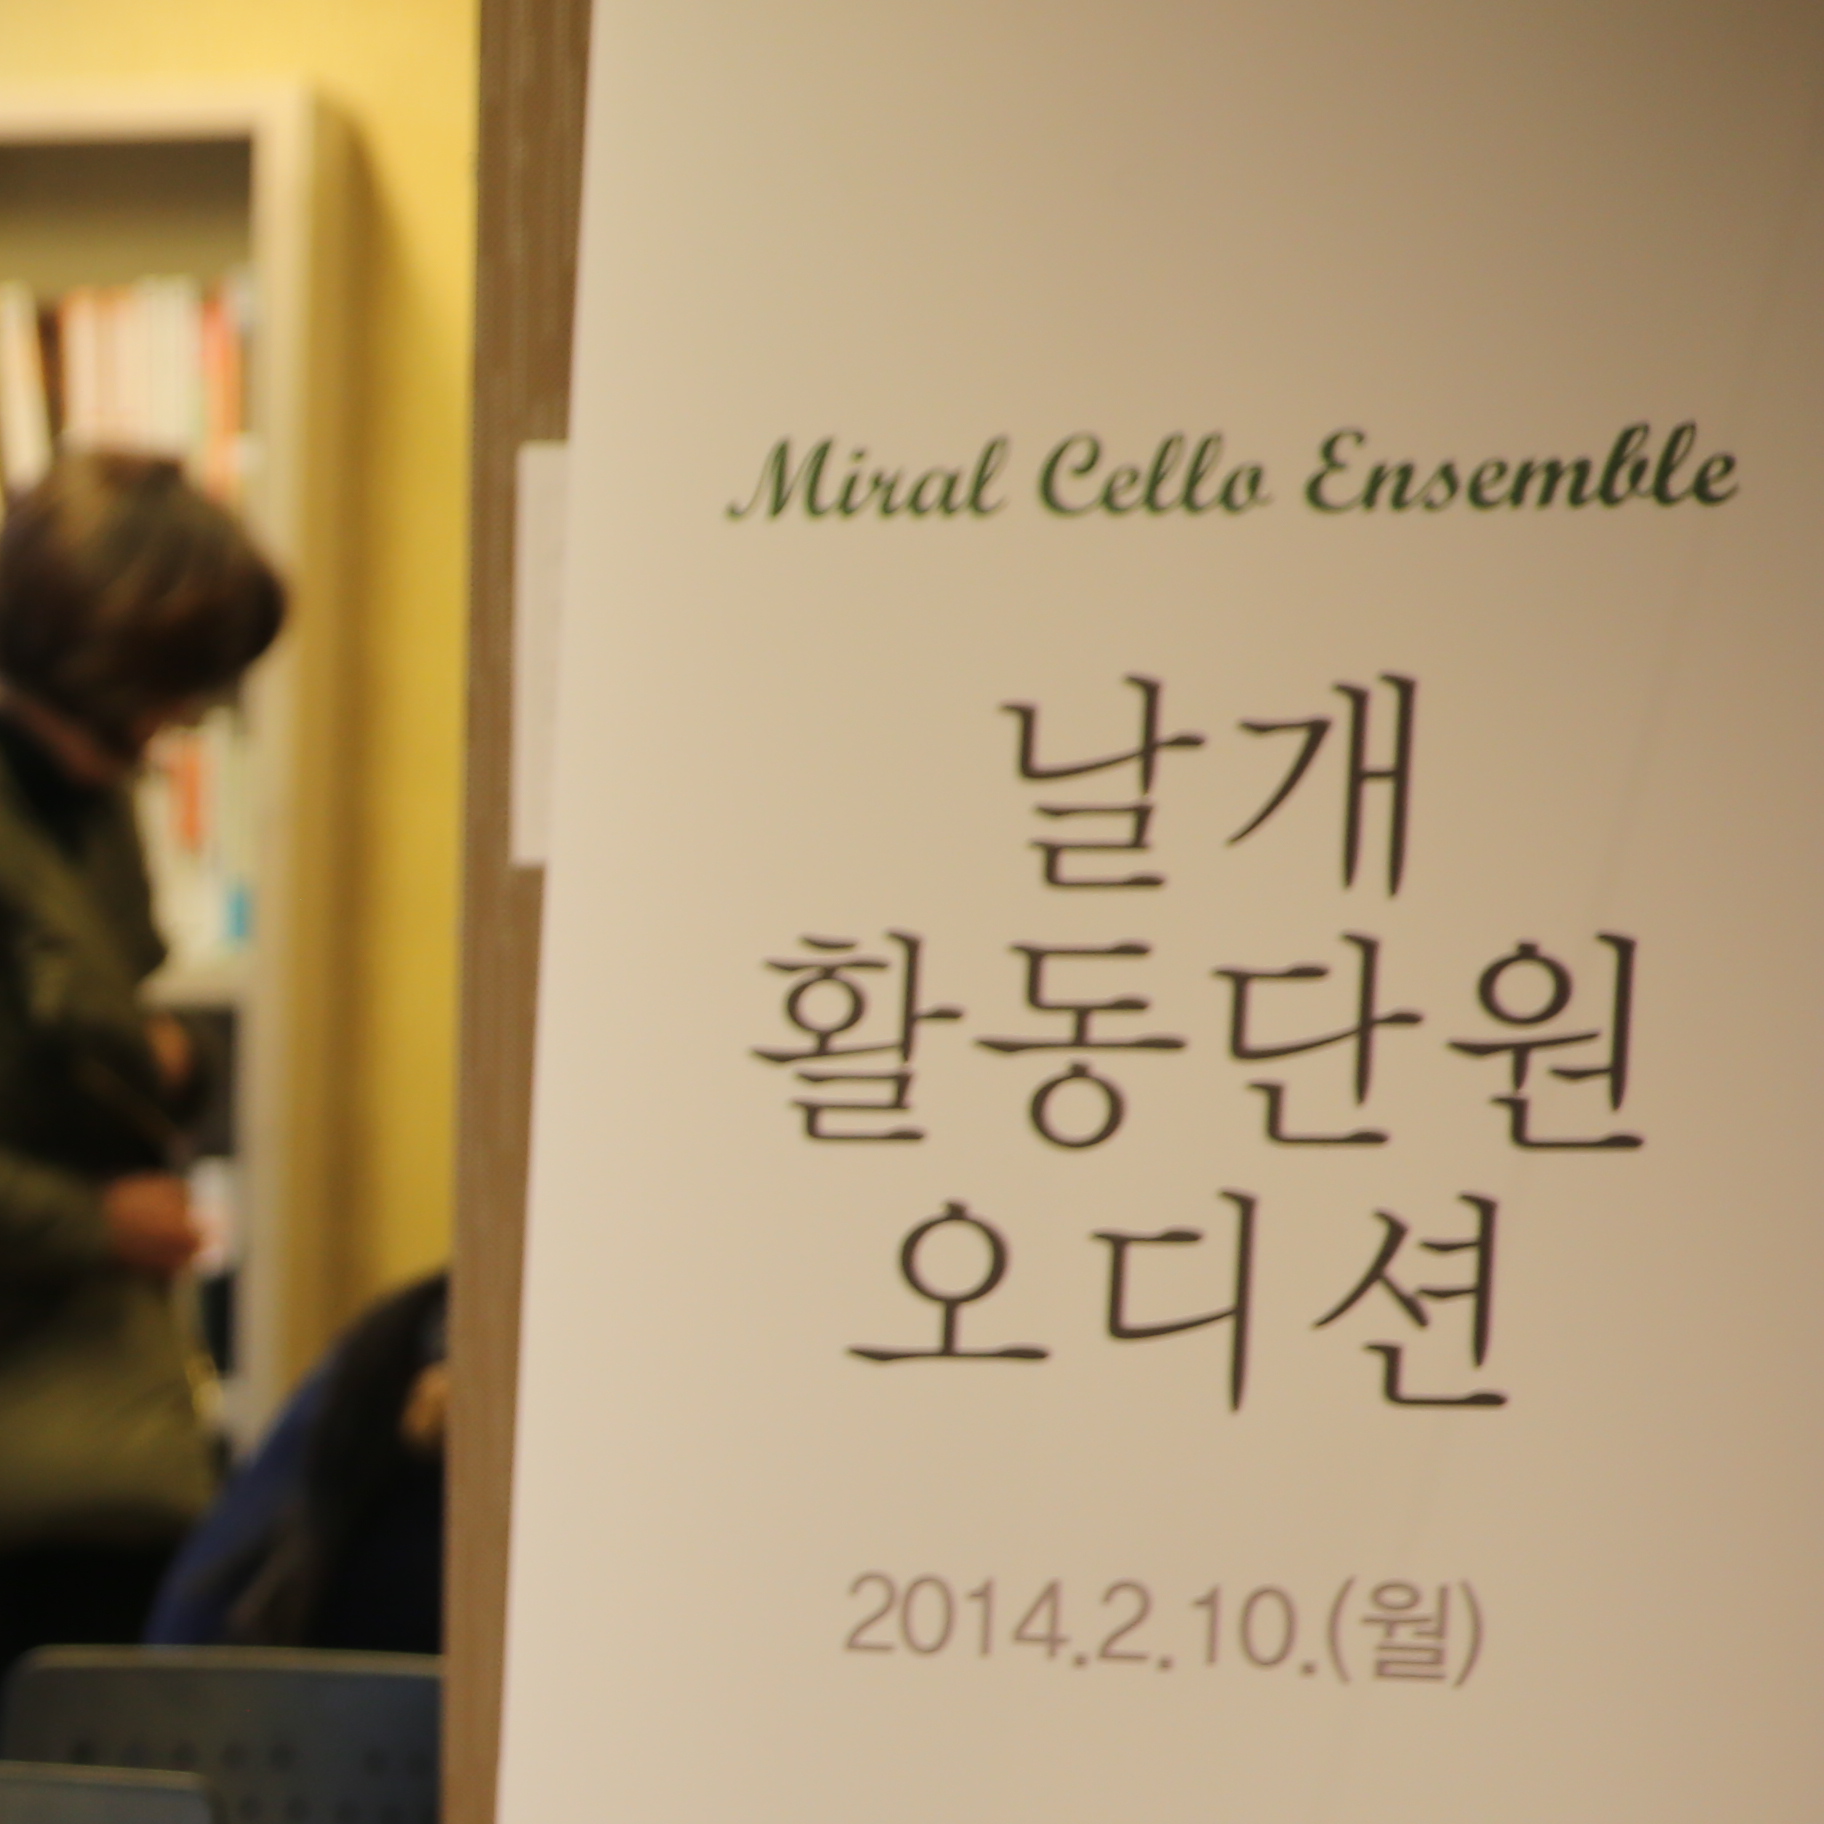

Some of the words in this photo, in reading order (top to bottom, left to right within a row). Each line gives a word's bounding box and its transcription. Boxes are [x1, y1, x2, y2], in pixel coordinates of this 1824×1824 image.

[725, 435, 1008, 522] Miral
[1036, 432, 1270, 520] Cello
[1302, 420, 1742, 516] Ensemble
[1000, 672, 1419, 899] 날개
[751, 929, 1646, 1153] 활동단원
[846, 1188, 1509, 1413] 오디션
[842, 1570, 1486, 1689] 2014.2.10.(월)
